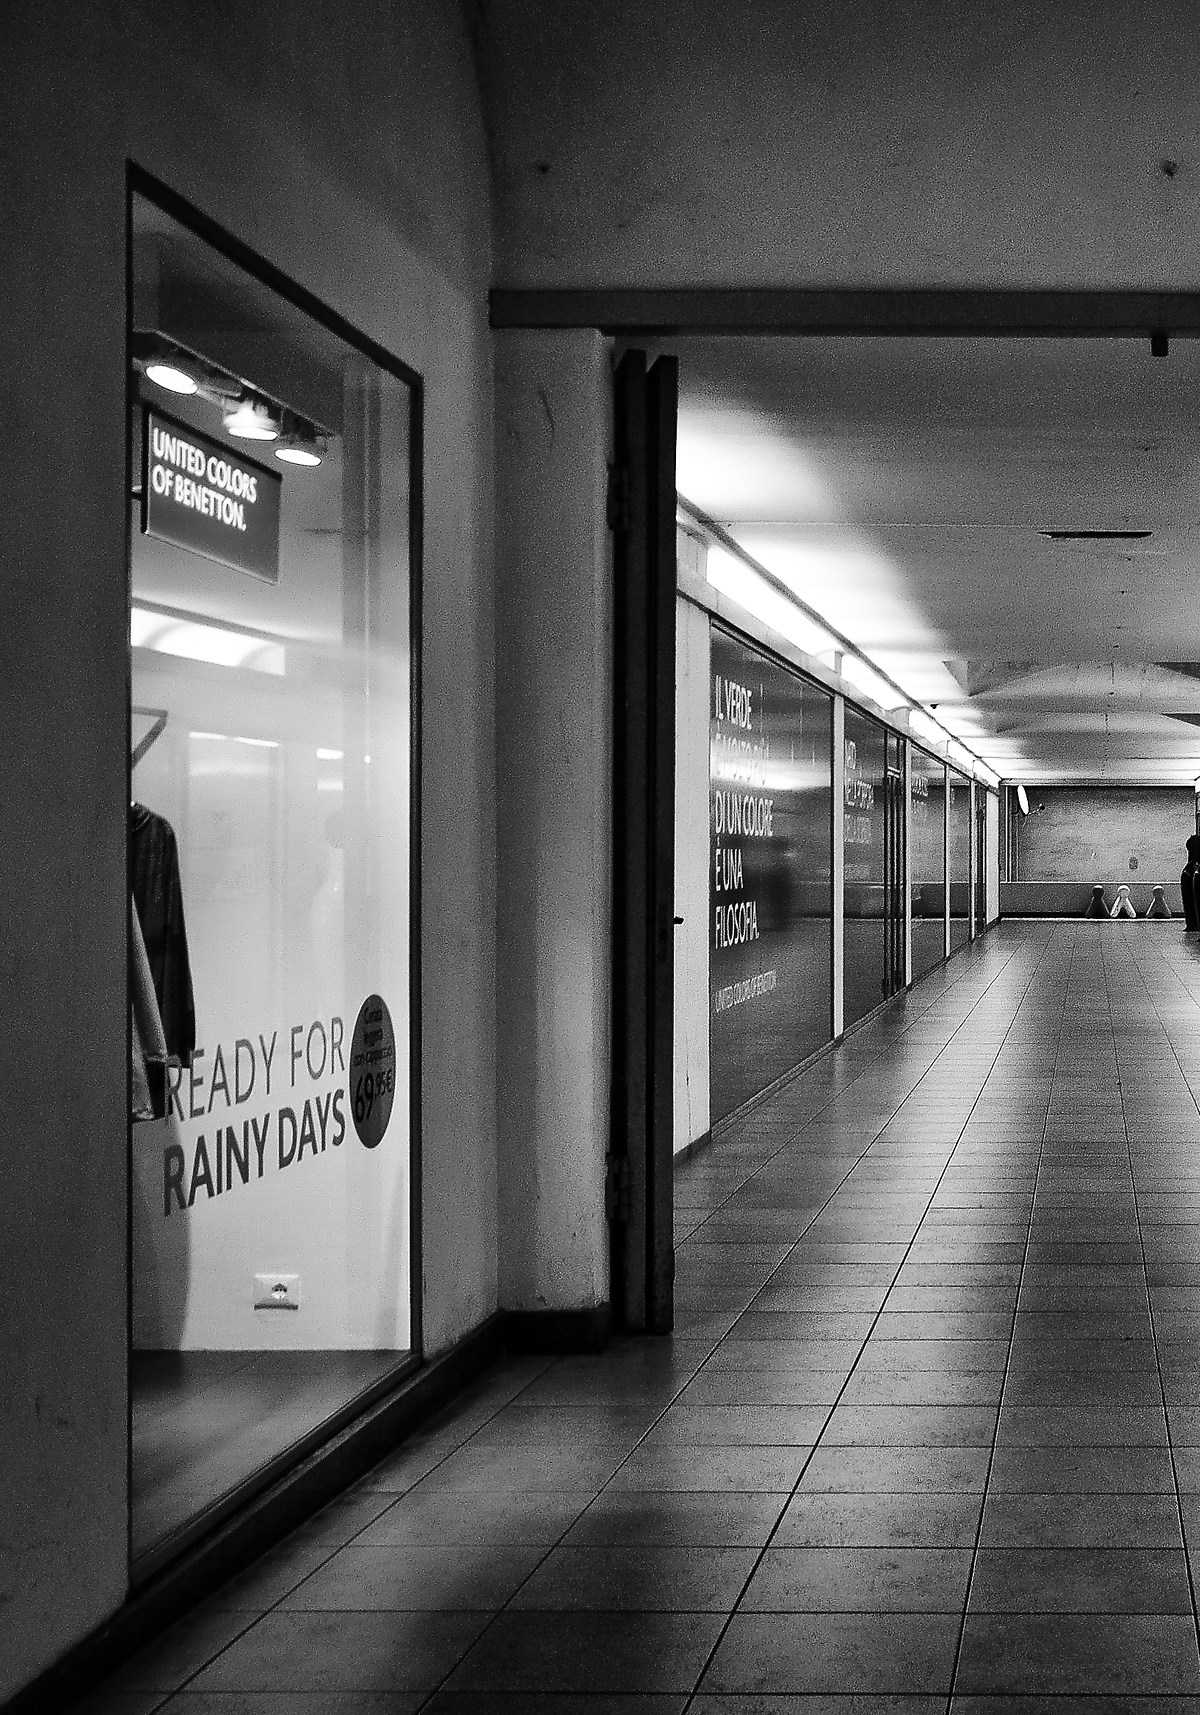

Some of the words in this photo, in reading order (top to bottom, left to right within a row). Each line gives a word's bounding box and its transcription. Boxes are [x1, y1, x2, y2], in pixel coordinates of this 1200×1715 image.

[152, 427, 206, 479] UNITED
[206, 456, 258, 504] COLORS
[152, 464, 174, 497] OF
[715, 674, 724, 720] IL
[724, 679, 753, 731] VERDE
[715, 789, 726, 835] DI
[727, 791, 742, 836] UN
[742, 794, 774, 837] COLORE
[722, 848, 744, 892] UNA
[164, 1030, 278, 1122] READY
[290, 1016, 346, 1088] FOR
[163, 1113, 270, 1217] RAINY
[278, 1088, 347, 1170] DAYS
